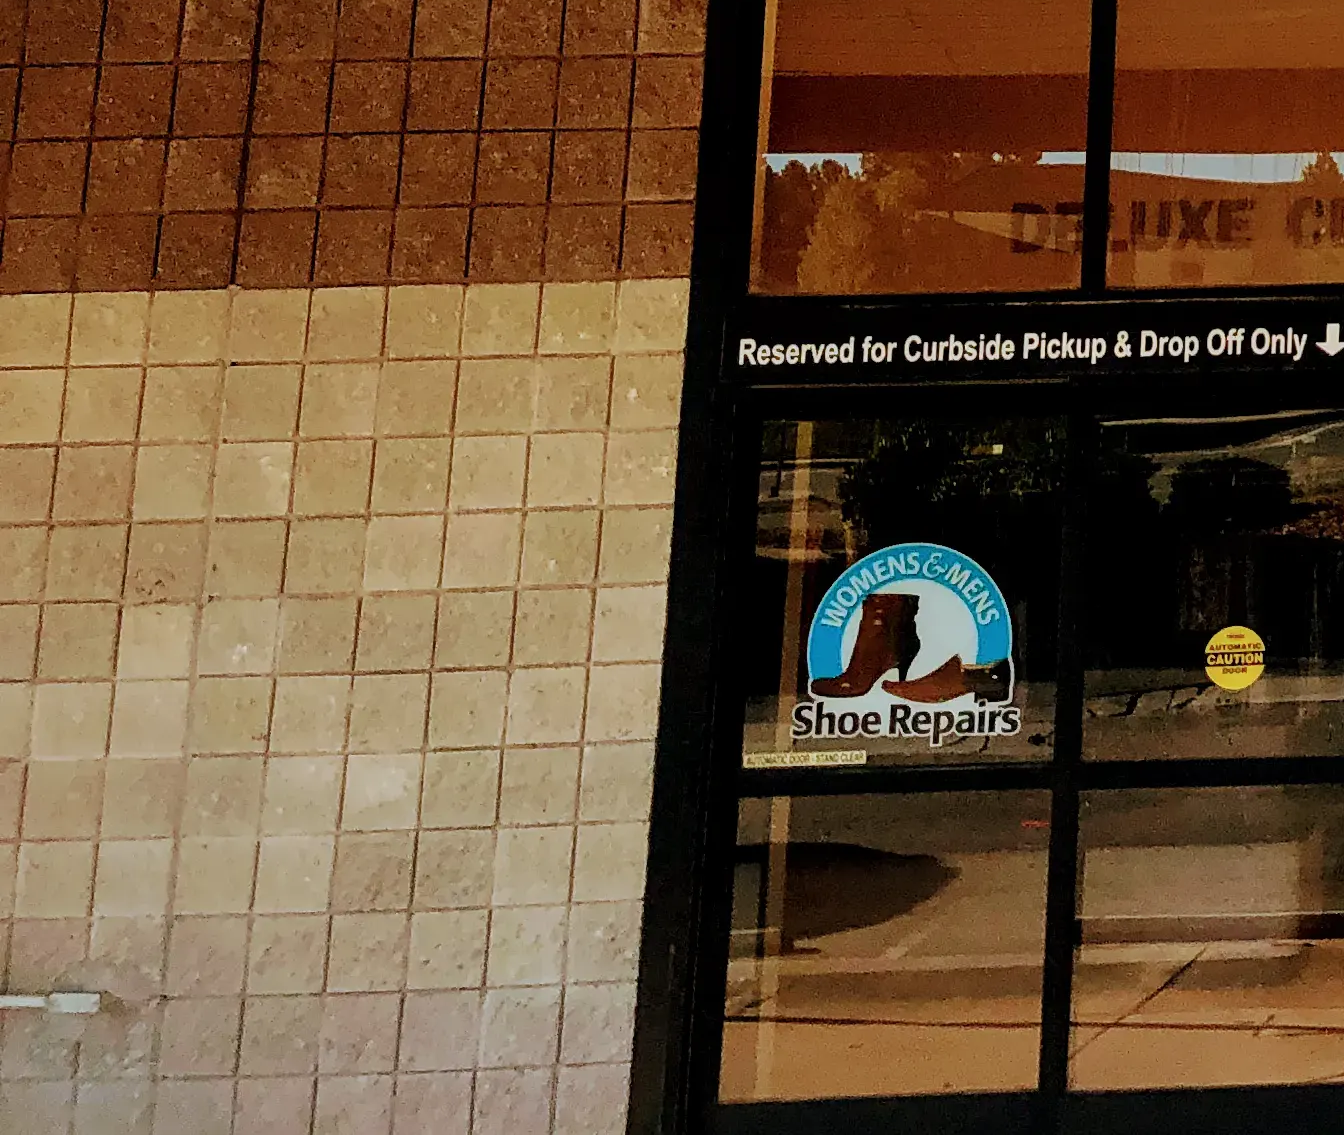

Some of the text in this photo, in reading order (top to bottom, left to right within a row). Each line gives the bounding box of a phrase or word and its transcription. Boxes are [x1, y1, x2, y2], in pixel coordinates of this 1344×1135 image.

[738, 327, 1308, 366] Reserved for Curbside Pickup & Drop Off Only
[820, 552, 1000, 628] WOMENS & MENS
[1207, 652, 1263, 665] CAUTION
[1209, 643, 1261, 651] AUTOMATIC
[791, 701, 1020, 746] Shoe Repairs
